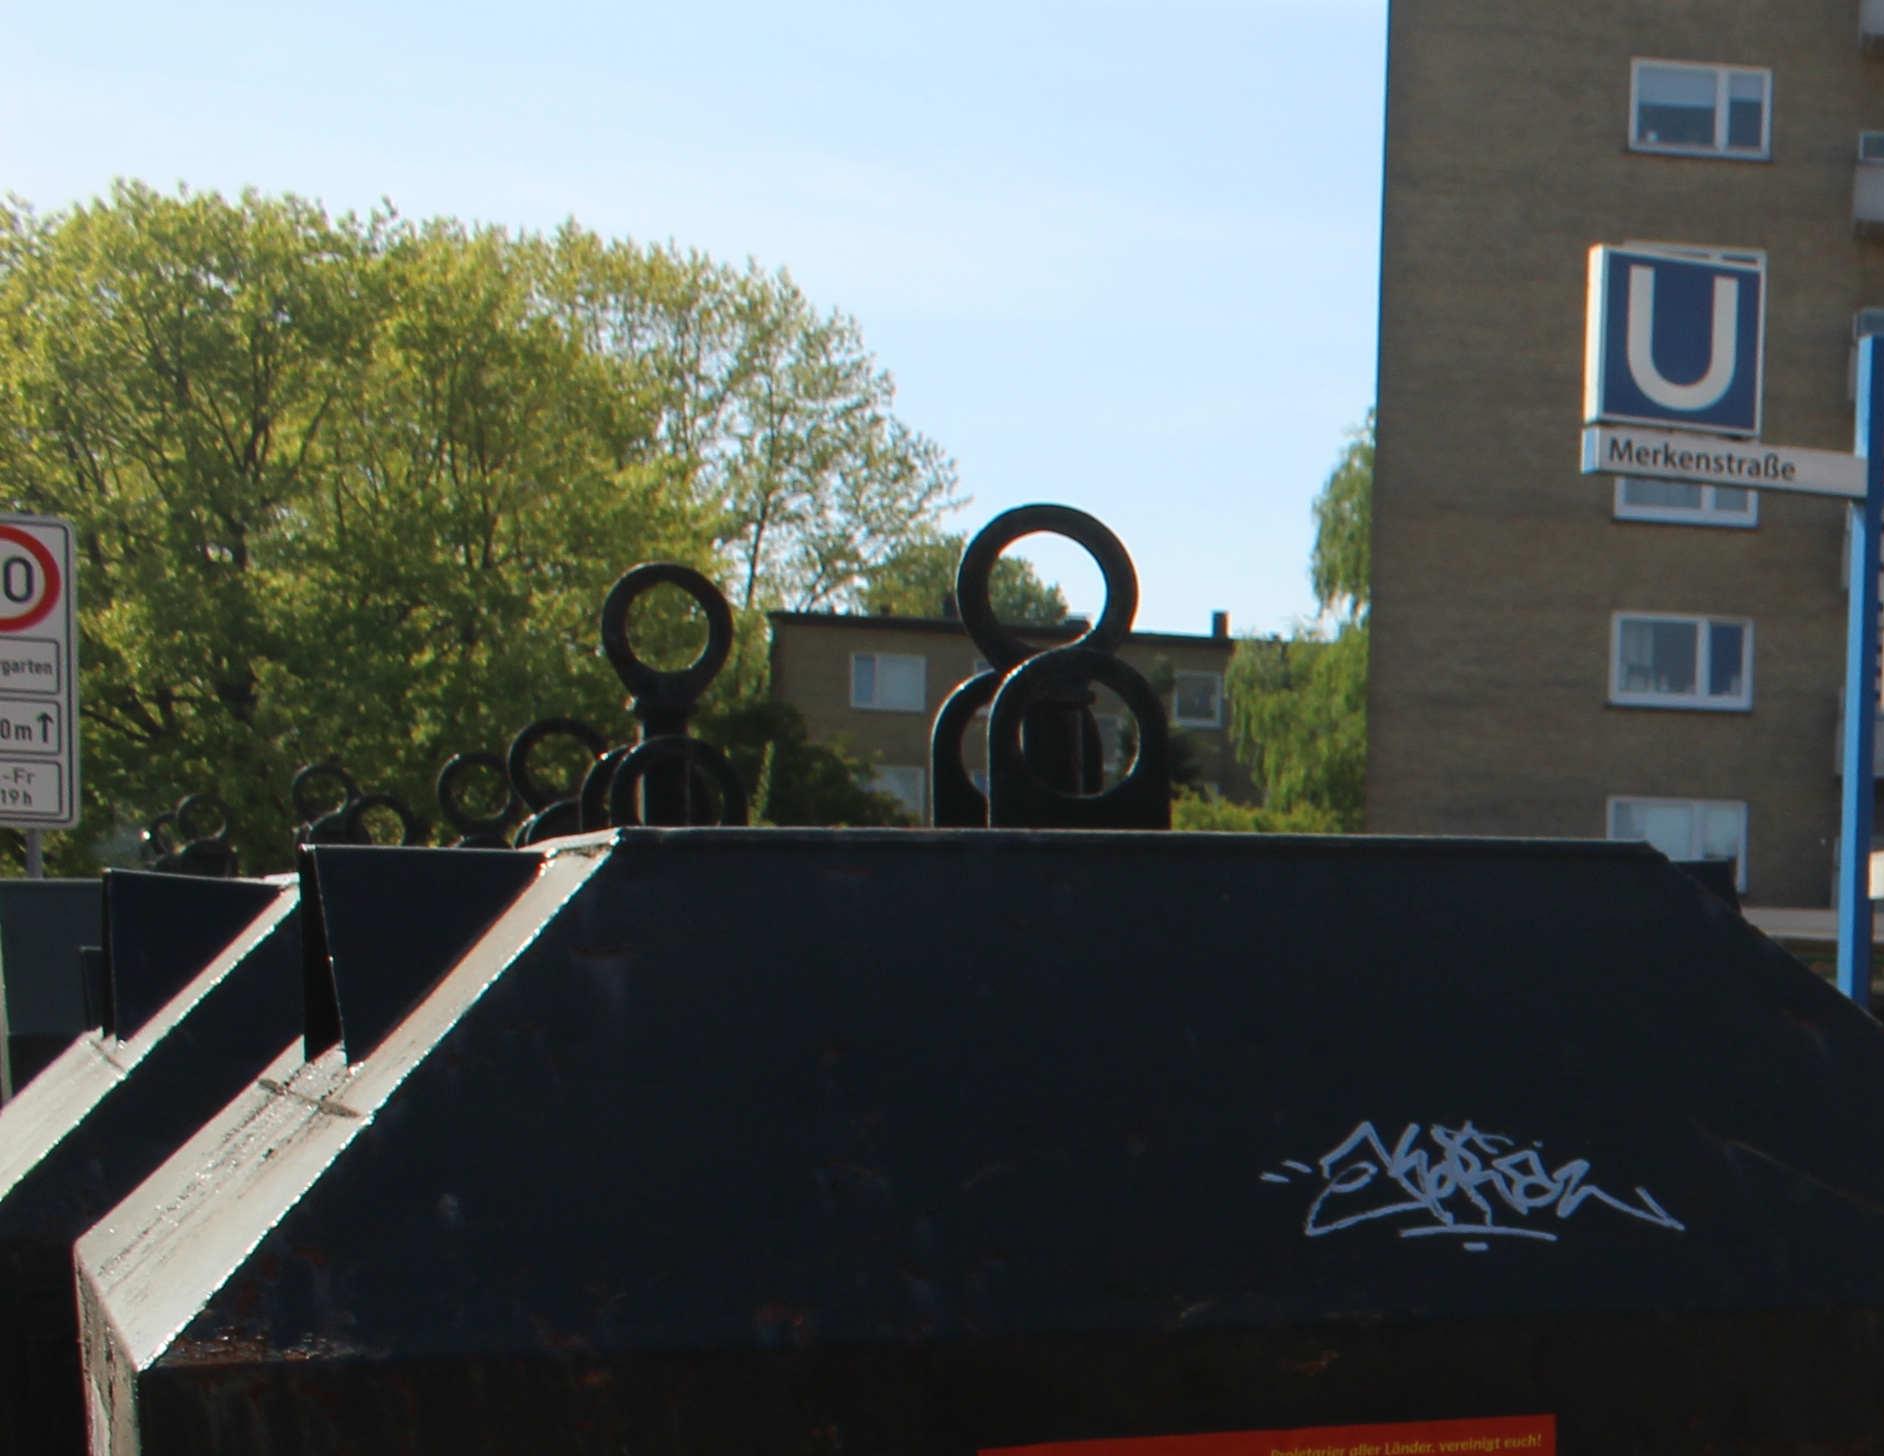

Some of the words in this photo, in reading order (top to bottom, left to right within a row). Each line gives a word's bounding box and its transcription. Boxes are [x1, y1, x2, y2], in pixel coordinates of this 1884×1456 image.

[1626, 264, 1739, 412] U
[1608, 436, 1797, 481] Merkenstraße
[1349, 1442, 1381, 1456] aller
[1439, 1436, 1500, 1454] vereinigt
[1504, 1432, 1543, 1449] euch!
